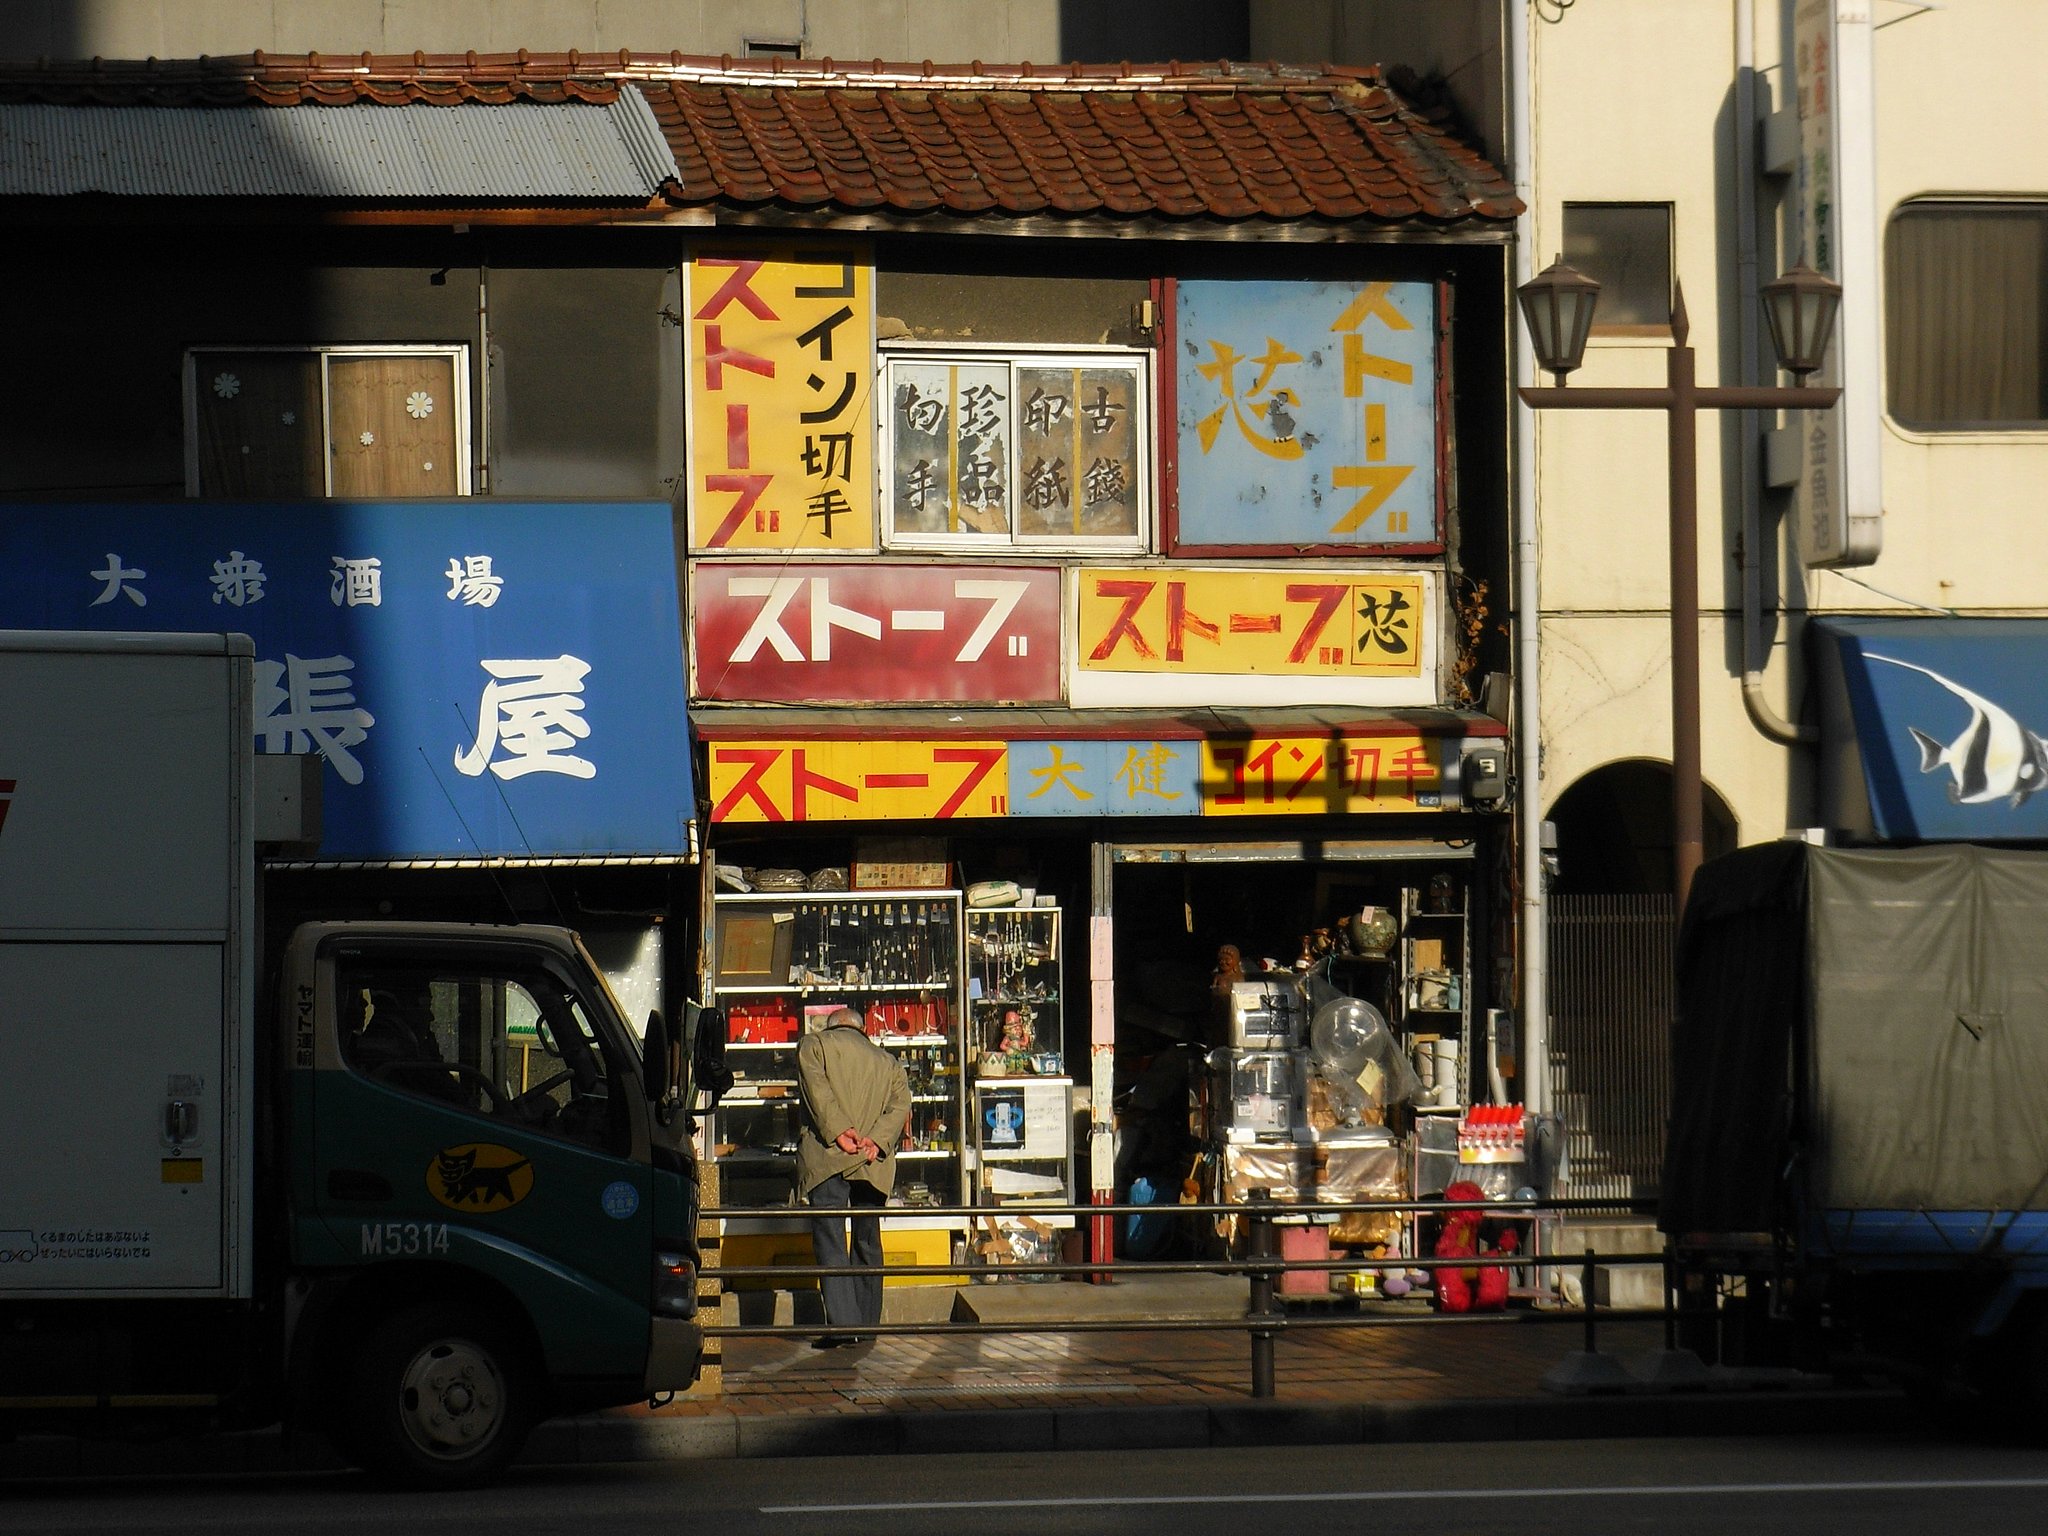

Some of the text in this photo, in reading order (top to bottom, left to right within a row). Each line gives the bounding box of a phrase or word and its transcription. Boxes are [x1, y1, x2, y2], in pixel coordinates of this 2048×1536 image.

[694, 253, 780, 548] ストーブ
[794, 252, 857, 539] コイン切手
[959, 384, 1006, 507] 珍品
[1024, 387, 1070, 510] 印紙
[90, 551, 504, 607] 大衆酒場
[728, 577, 1031, 662] ストーブ
[1088, 579, 1410, 665] ストーブ 芯
[711, 748, 1007, 822] ストーブ
[1027, 742, 1184, 801] 大健
[1213, 741, 1435, 805] コイン切手
[297, 985, 313, 1066] ヤマト運輸
[40, 1231, 151, 1243] くるまのしたはあぶないよ
[40, 1247, 151, 1259] ぜったいにはいらないでね
[361, 1223, 450, 1255] M5314
